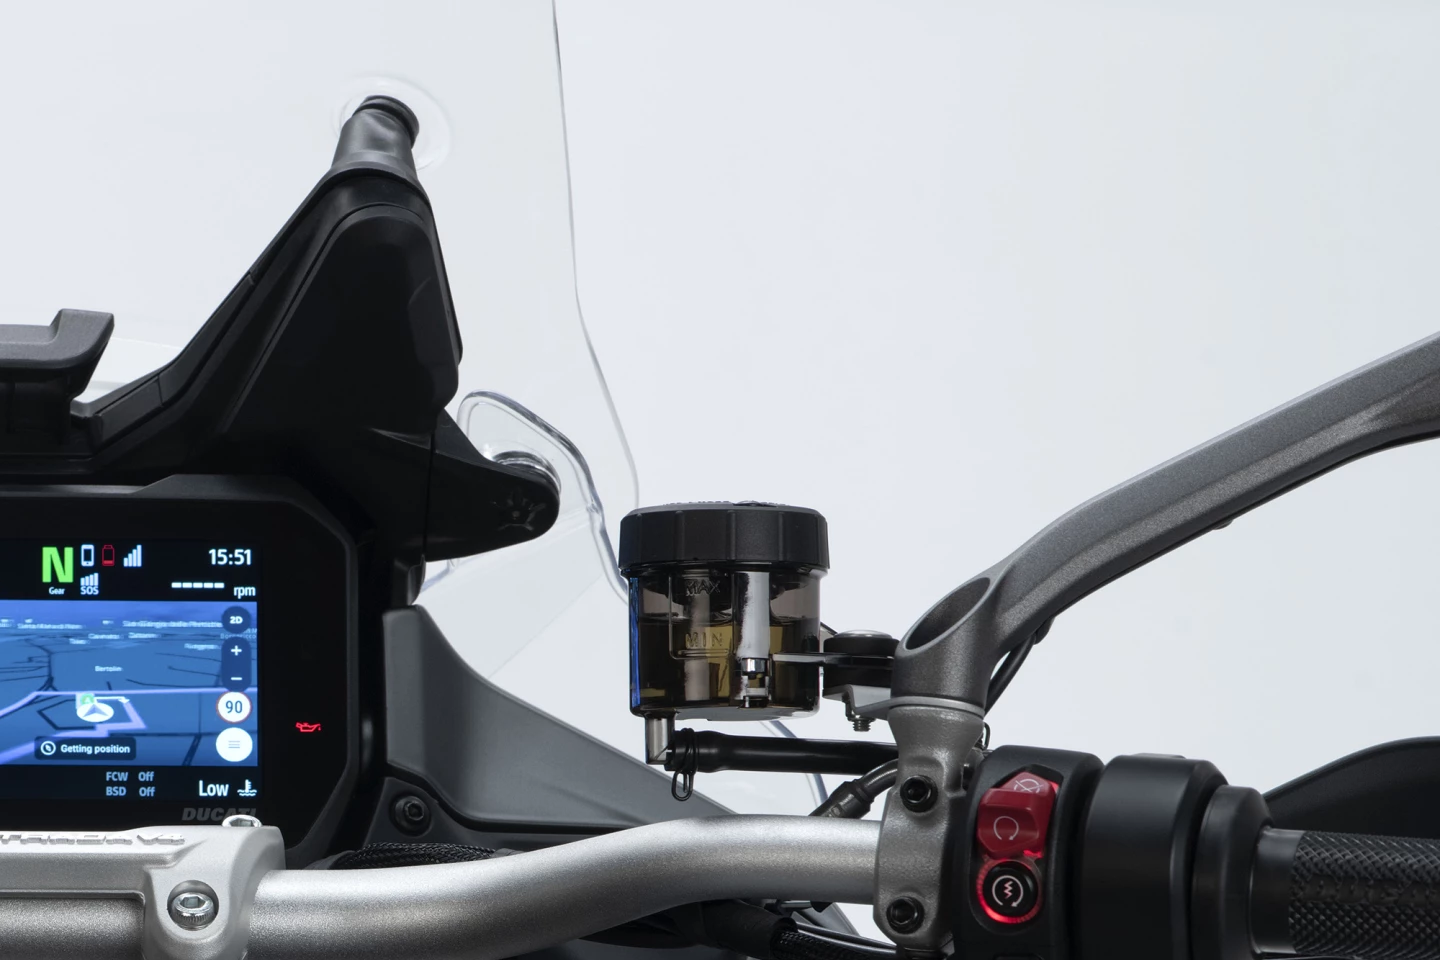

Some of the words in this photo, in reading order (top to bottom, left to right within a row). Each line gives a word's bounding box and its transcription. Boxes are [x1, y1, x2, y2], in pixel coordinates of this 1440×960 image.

[208, 548, 252, 566] 15:51
[42, 547, 74, 583] N
[48, 586, 66, 595] Gear
[80, 586, 99, 595] SOS
[233, 586, 256, 599] rpm
[684, 578, 721, 596] MAX
[229, 616, 243, 624] 2D
[685, 632, 723, 650] MIN
[225, 700, 243, 714] 90
[61, 744, 93, 755] Getting
[95, 744, 130, 755] position
[106, 772, 128, 782] FCW
[138, 771, 154, 782] Off
[106, 787, 127, 797] BSD
[139, 786, 155, 797] Off
[198, 780, 229, 797] Low
